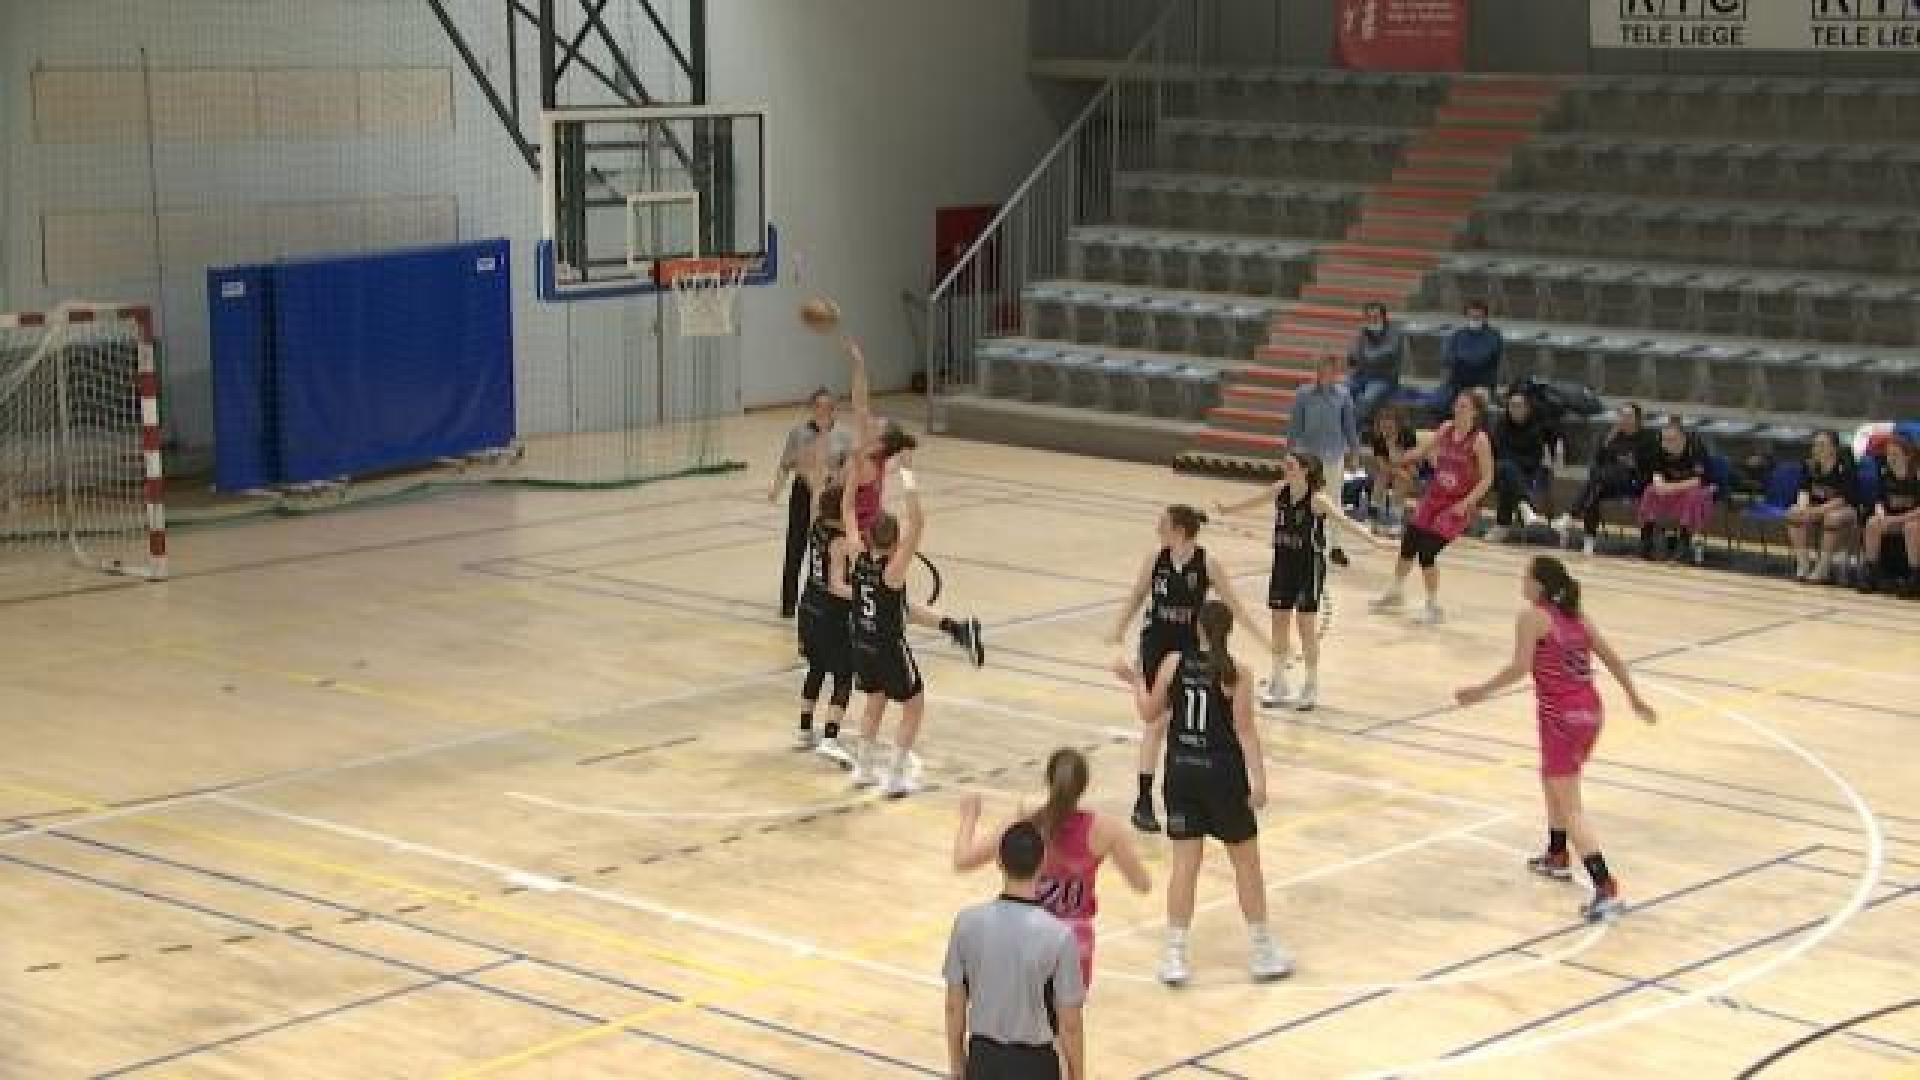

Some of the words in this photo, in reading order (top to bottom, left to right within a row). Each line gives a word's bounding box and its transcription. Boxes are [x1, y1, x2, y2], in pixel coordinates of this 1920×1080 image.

[1620, 24, 1672, 44] TELE
[1679, 25, 1744, 46] LIEGE
[1810, 26, 1870, 46] TELE
[1877, 26, 1920, 46] LIE
[861, 581, 876, 616] 5
[1184, 688, 1208, 731] 11
